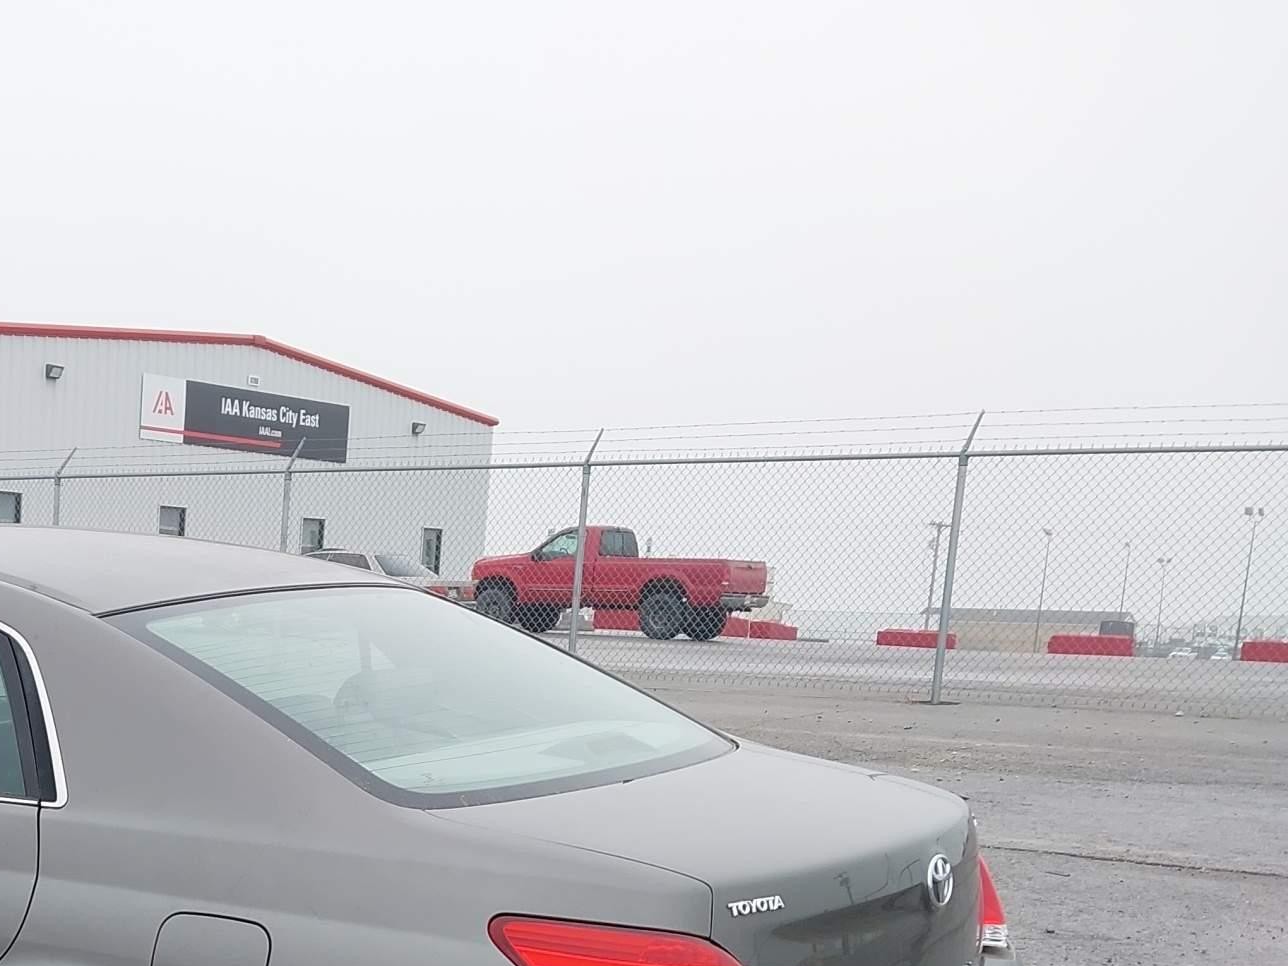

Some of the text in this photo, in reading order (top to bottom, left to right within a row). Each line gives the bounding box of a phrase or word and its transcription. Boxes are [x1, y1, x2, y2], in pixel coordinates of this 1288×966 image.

[221, 397, 320, 428] IAA Kansas City East
[727, 895, 785, 917] TOYOTA
